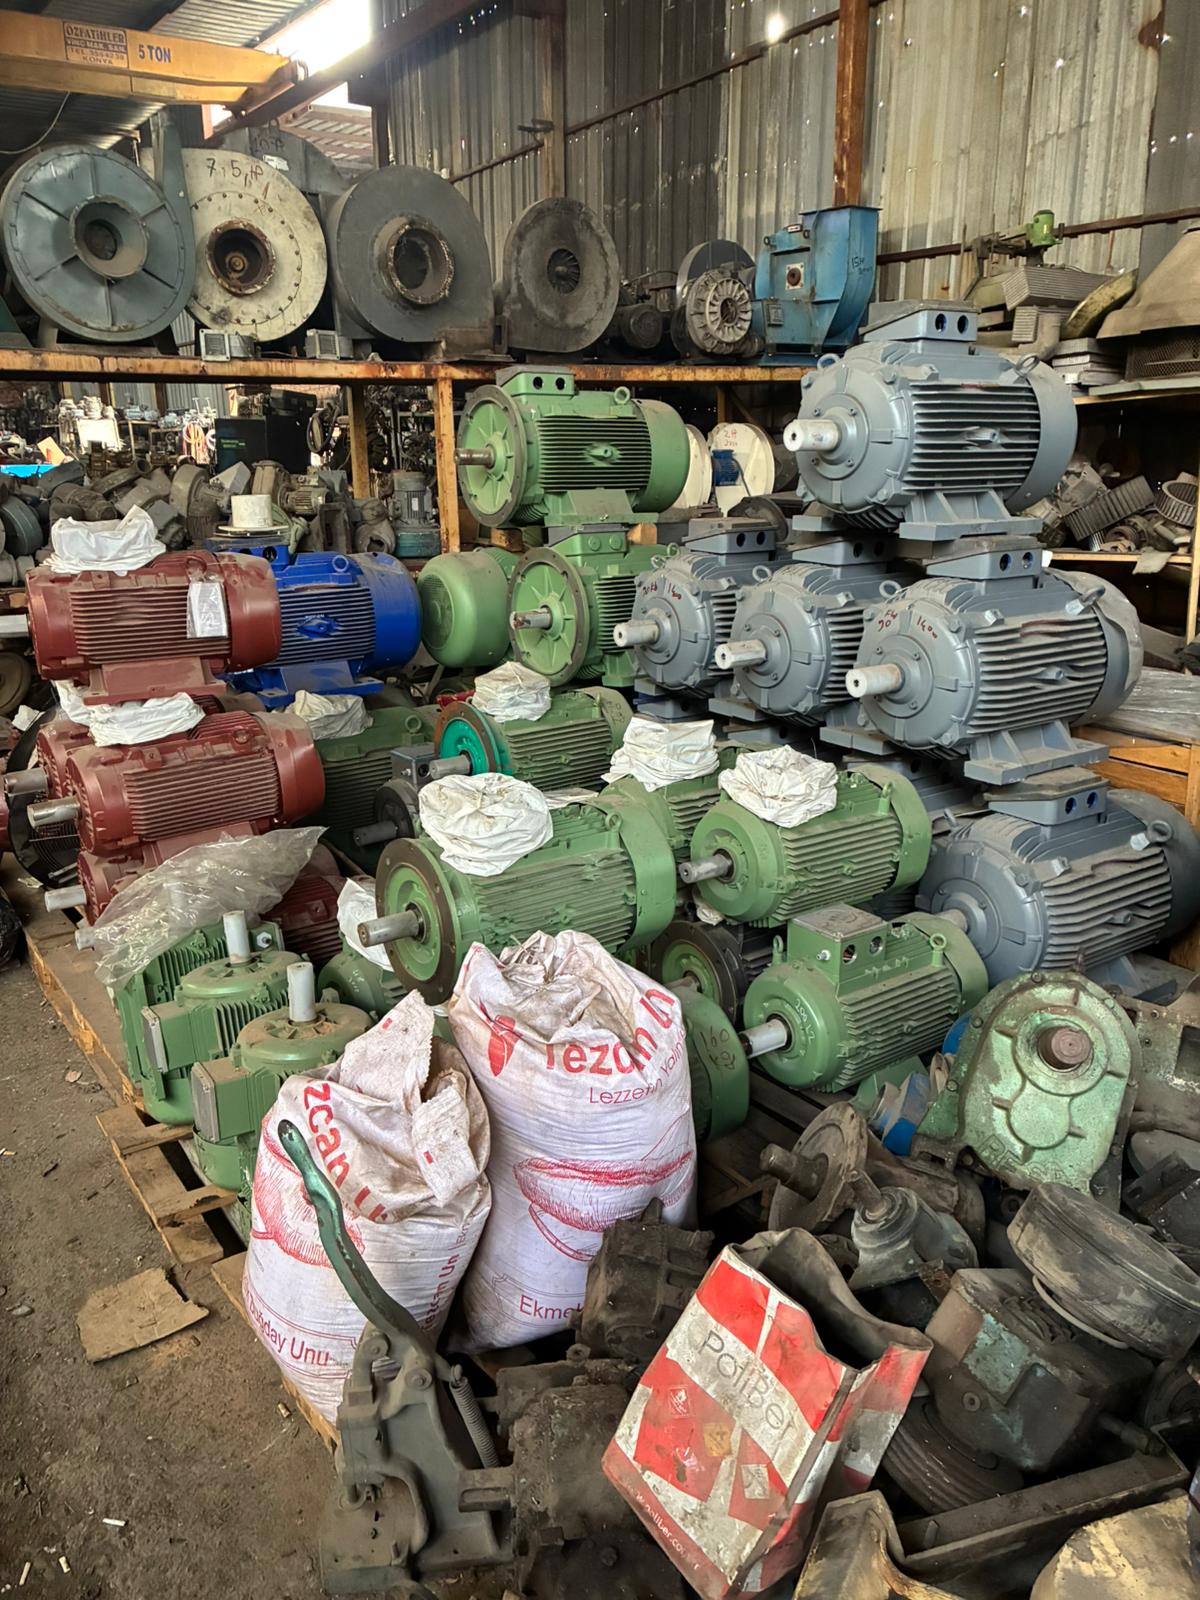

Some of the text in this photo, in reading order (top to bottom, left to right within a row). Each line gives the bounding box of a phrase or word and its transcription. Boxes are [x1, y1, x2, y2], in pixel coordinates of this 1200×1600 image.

[82, 55, 113, 65] KONYA
[138, 44, 172, 63] 5 TON
[303, 1082, 350, 1189] zcan
[438, 1253, 460, 1279] Un
[289, 1336, 330, 1367] Unu
